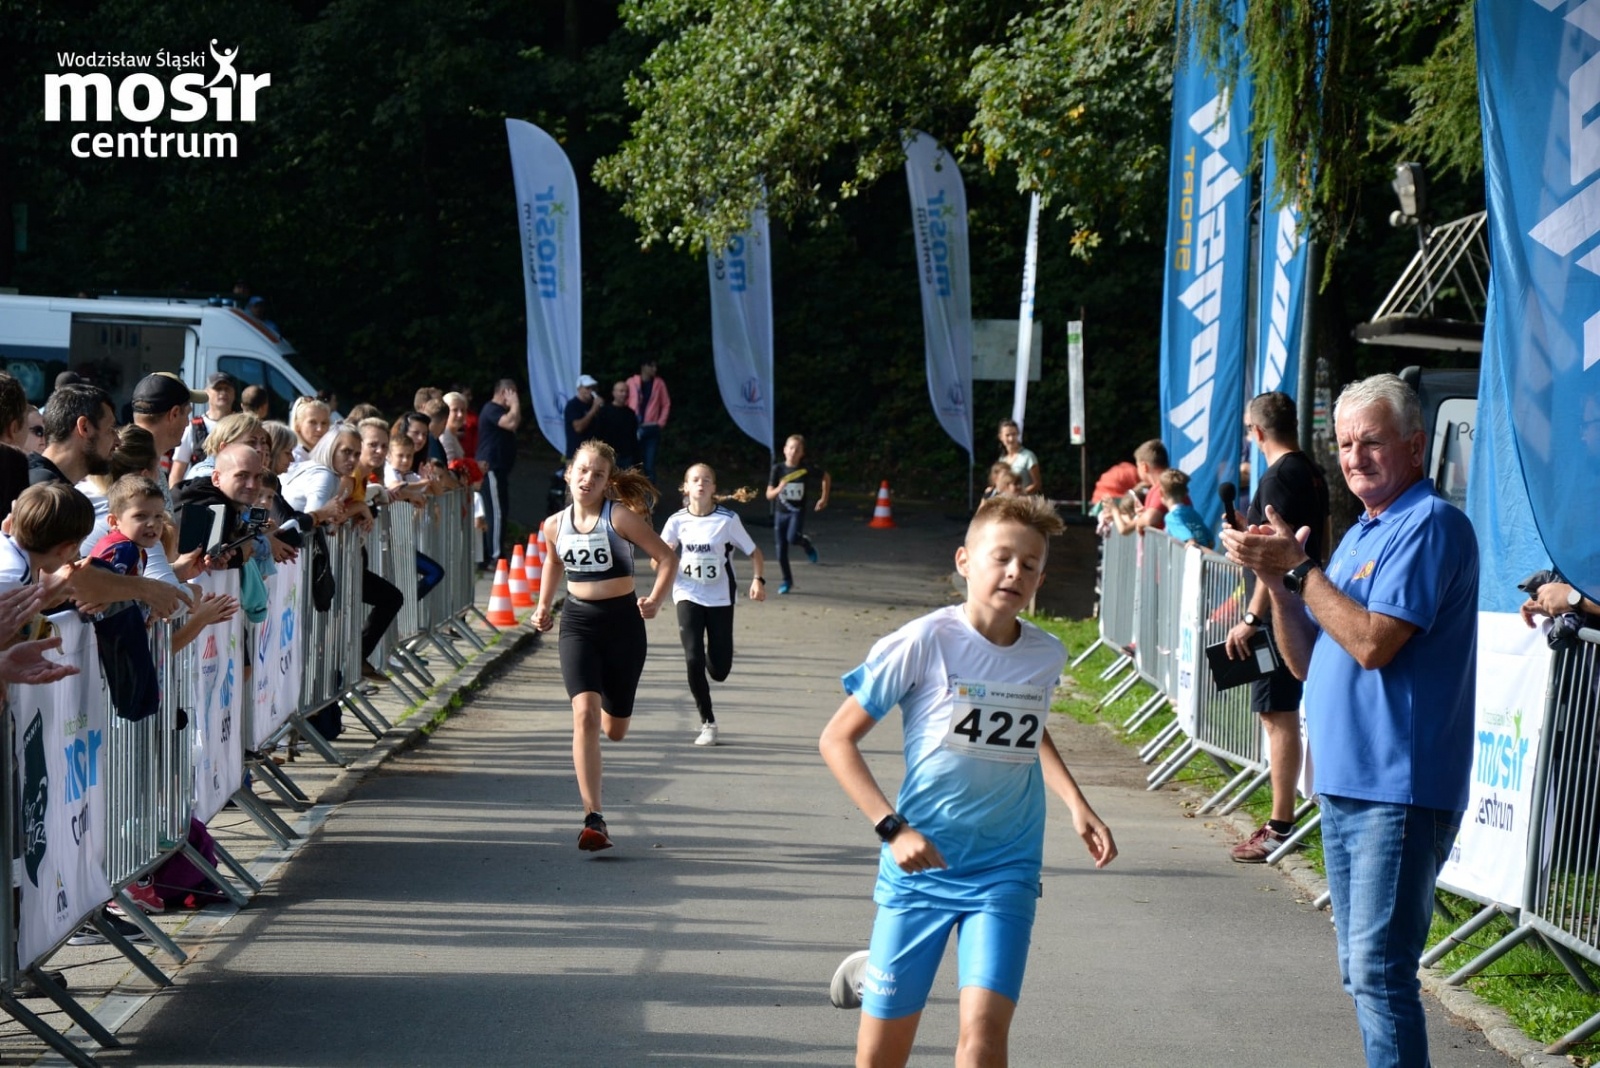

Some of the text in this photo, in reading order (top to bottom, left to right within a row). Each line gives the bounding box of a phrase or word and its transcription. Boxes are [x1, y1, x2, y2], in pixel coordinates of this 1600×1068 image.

[563, 547, 609, 566] 426
[683, 564, 717, 579] 413
[953, 708, 1039, 749] 422
[1477, 729, 1529, 792] mosir
